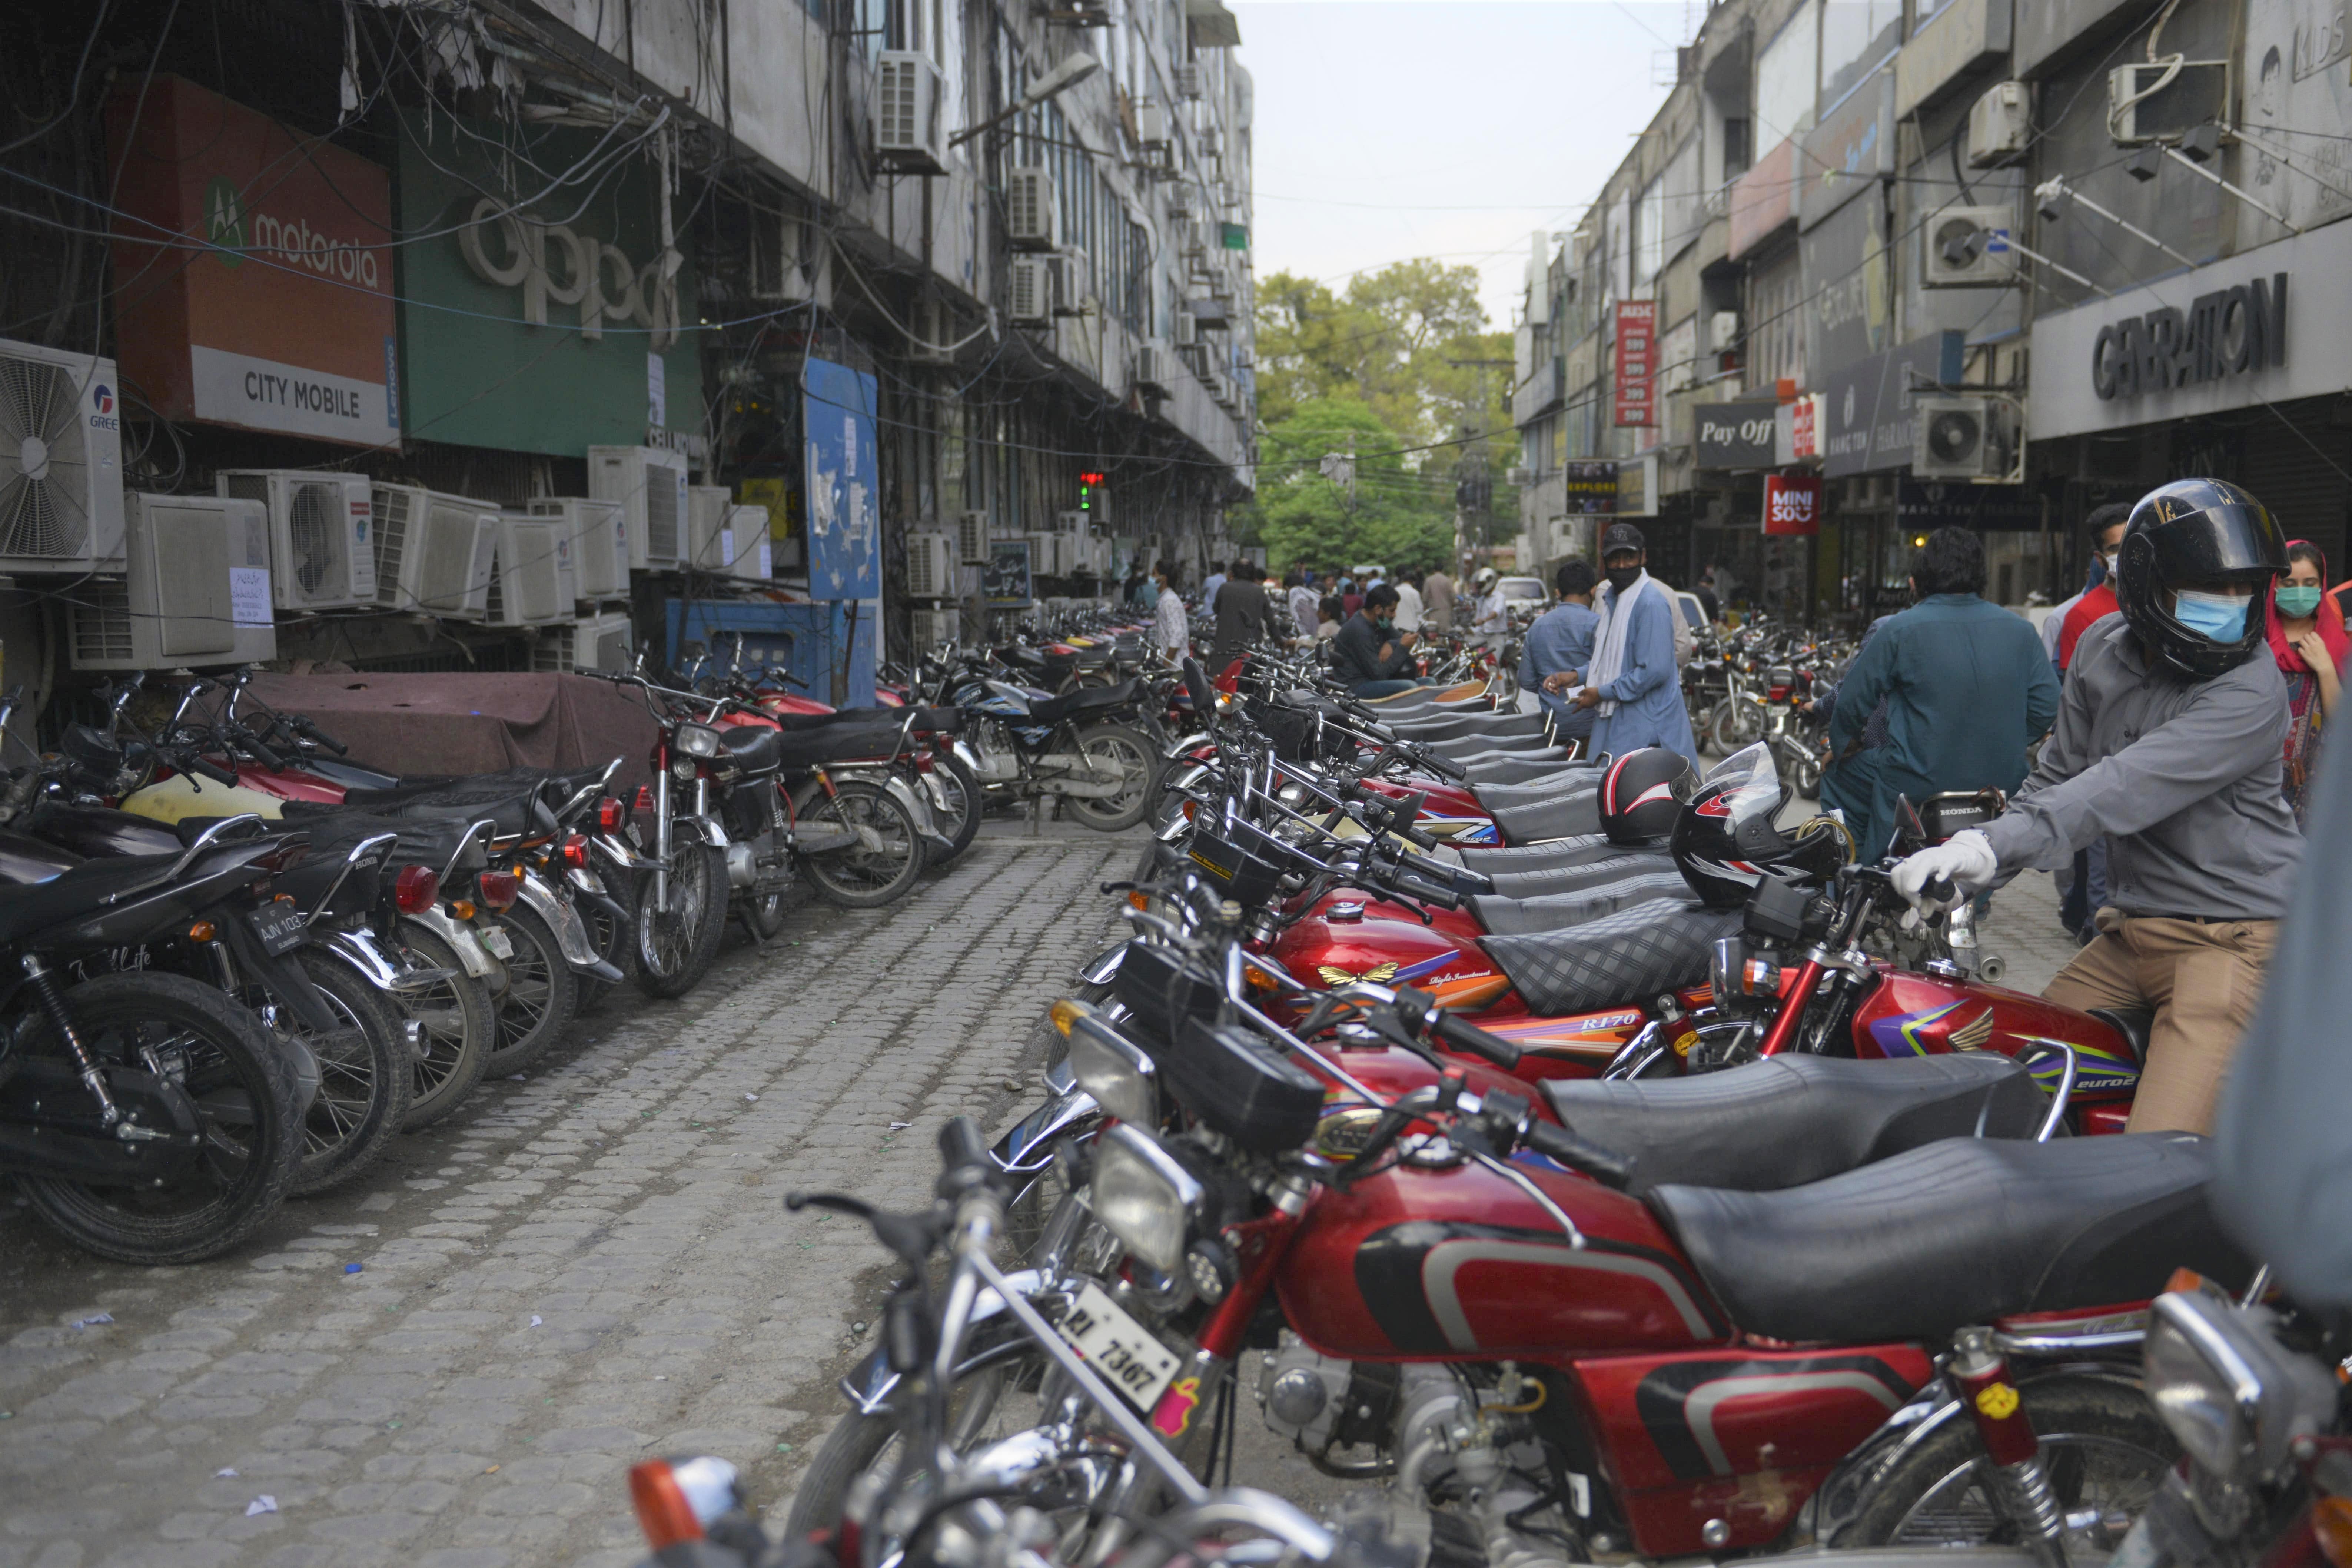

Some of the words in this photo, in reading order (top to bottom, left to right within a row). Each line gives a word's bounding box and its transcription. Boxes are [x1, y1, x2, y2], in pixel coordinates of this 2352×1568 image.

[2295, 10, 2345, 76] KIDS
[255, 213, 378, 289] motorola
[245, 371, 288, 406] CITY
[295, 380, 360, 419] MOBILE
[388, 344, 397, 419] Lenovo
[90, 415, 118, 431] GREE
[1701, 422, 1736, 446] Pay
[1740, 419, 1775, 446] Off
[1772, 490, 1813, 506] MINI
[1940, 807, 1983, 815] HONDA
[355, 856, 378, 870] HONDA
[260, 922, 282, 942] AJN
[281, 915, 302, 932] 103
[1429, 973, 1452, 988] Right
[2077, 1076, 2136, 1089] euro2
[1098, 1339, 1156, 1392] 7367
